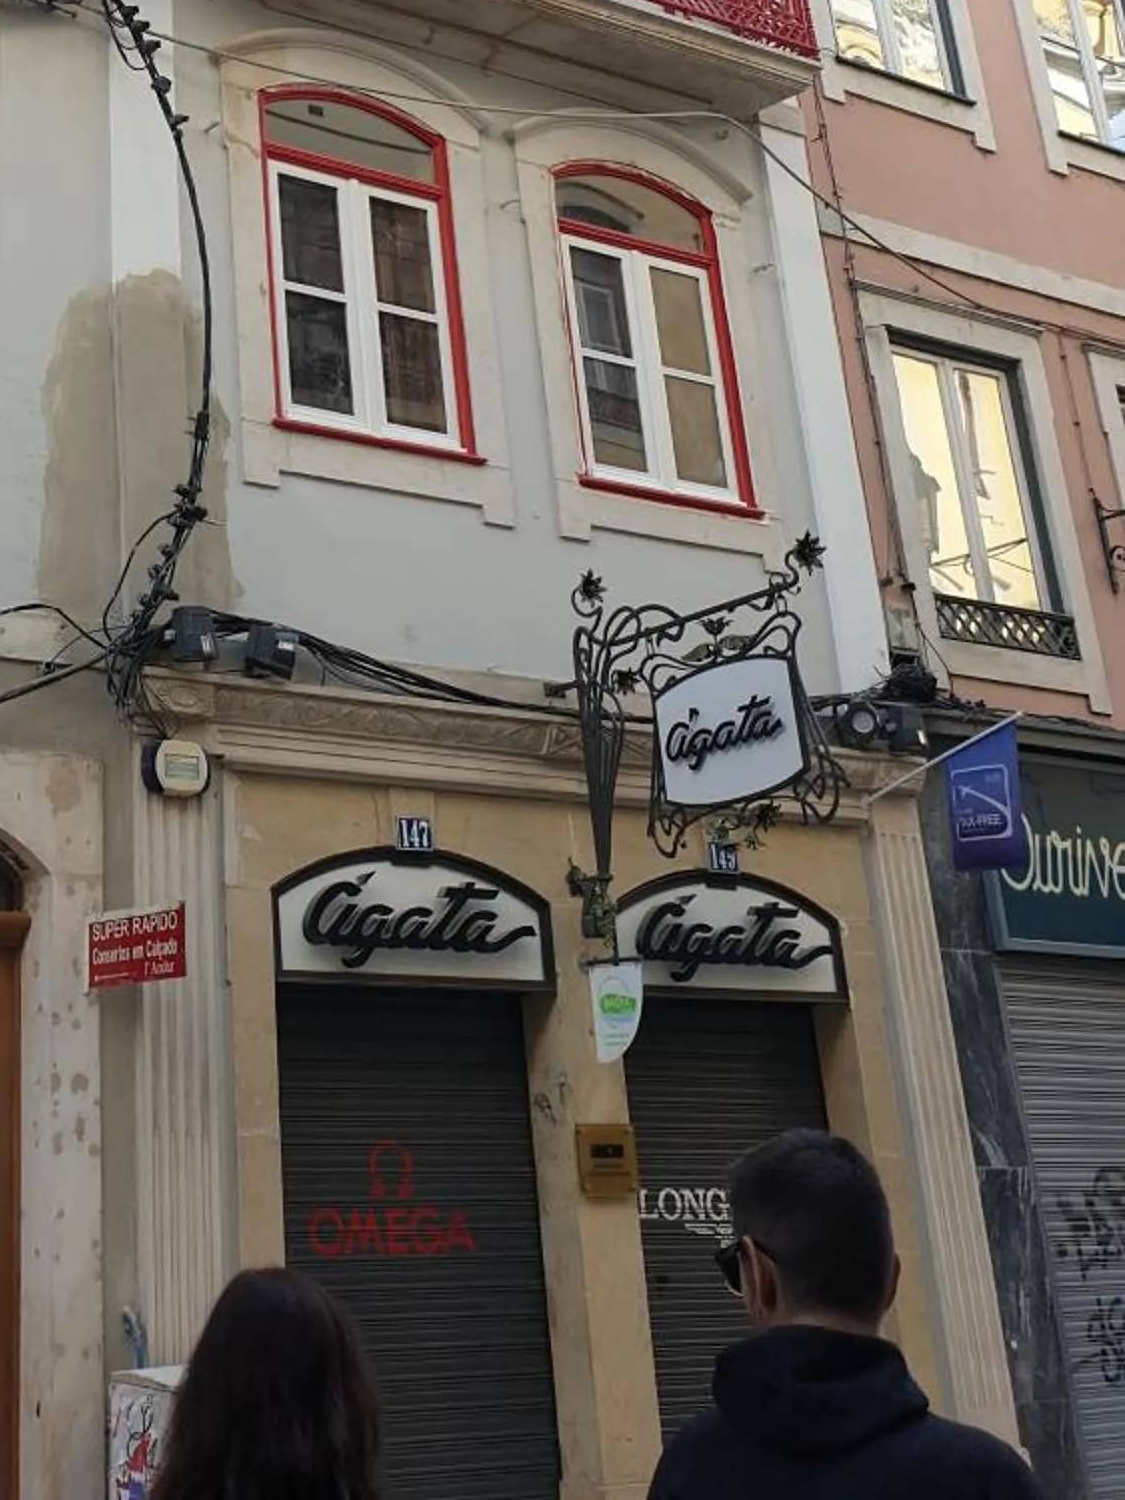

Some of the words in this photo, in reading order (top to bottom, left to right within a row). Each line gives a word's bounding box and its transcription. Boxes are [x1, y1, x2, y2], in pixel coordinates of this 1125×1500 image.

[401, 819, 429, 848] 147
[92, 918, 130, 941] SUPER
[302, 870, 538, 968] Ágata
[636, 894, 835, 983] Ágata
[639, 1187, 732, 1221] LONG
[308, 1202, 477, 1259] OMEGA
